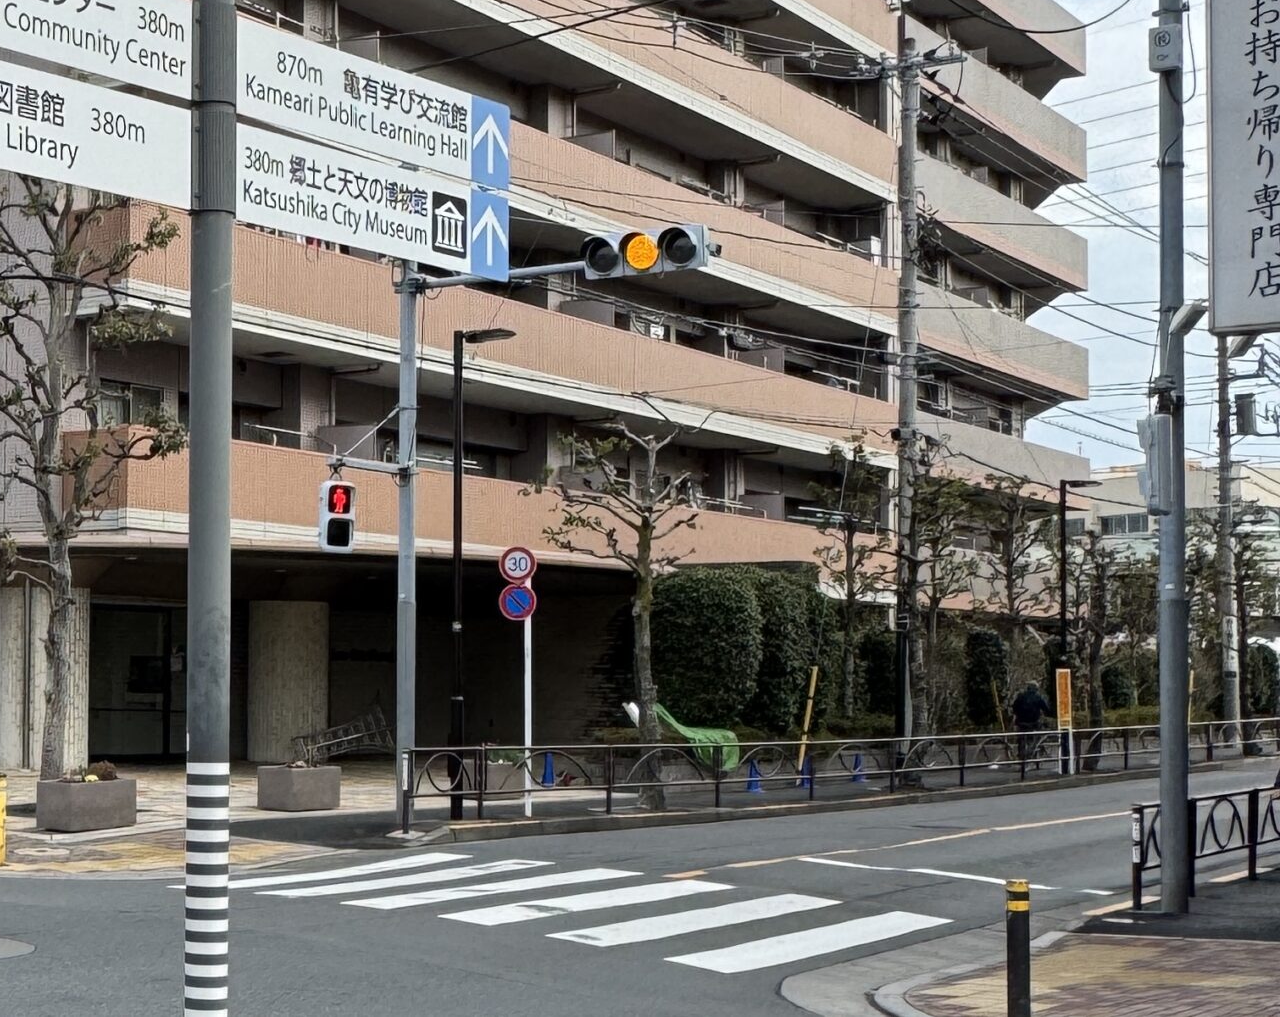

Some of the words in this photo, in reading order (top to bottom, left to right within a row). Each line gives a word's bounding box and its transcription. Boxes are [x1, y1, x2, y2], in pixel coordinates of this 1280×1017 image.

[4, 2, 120, 64] Community
[125, 39, 187, 77] Center
[137, 6, 185, 43] 380m
[277, 51, 323, 86] 870m
[343, 68, 468, 134] 亀有学び交流館
[90, 107, 146, 145] 380m
[246, 73, 314, 115] Kameari
[319, 96, 368, 132] Public
[371, 111, 436, 157] Learning
[441, 133, 468, 161] Hall
[6, 122, 79, 170] Library
[244, 146, 285, 178] 380m
[243, 179, 328, 222] Katsushika
[332, 202, 362, 234] City
[365, 209, 428, 246] Museum
[507, 556, 529, 573] 30
